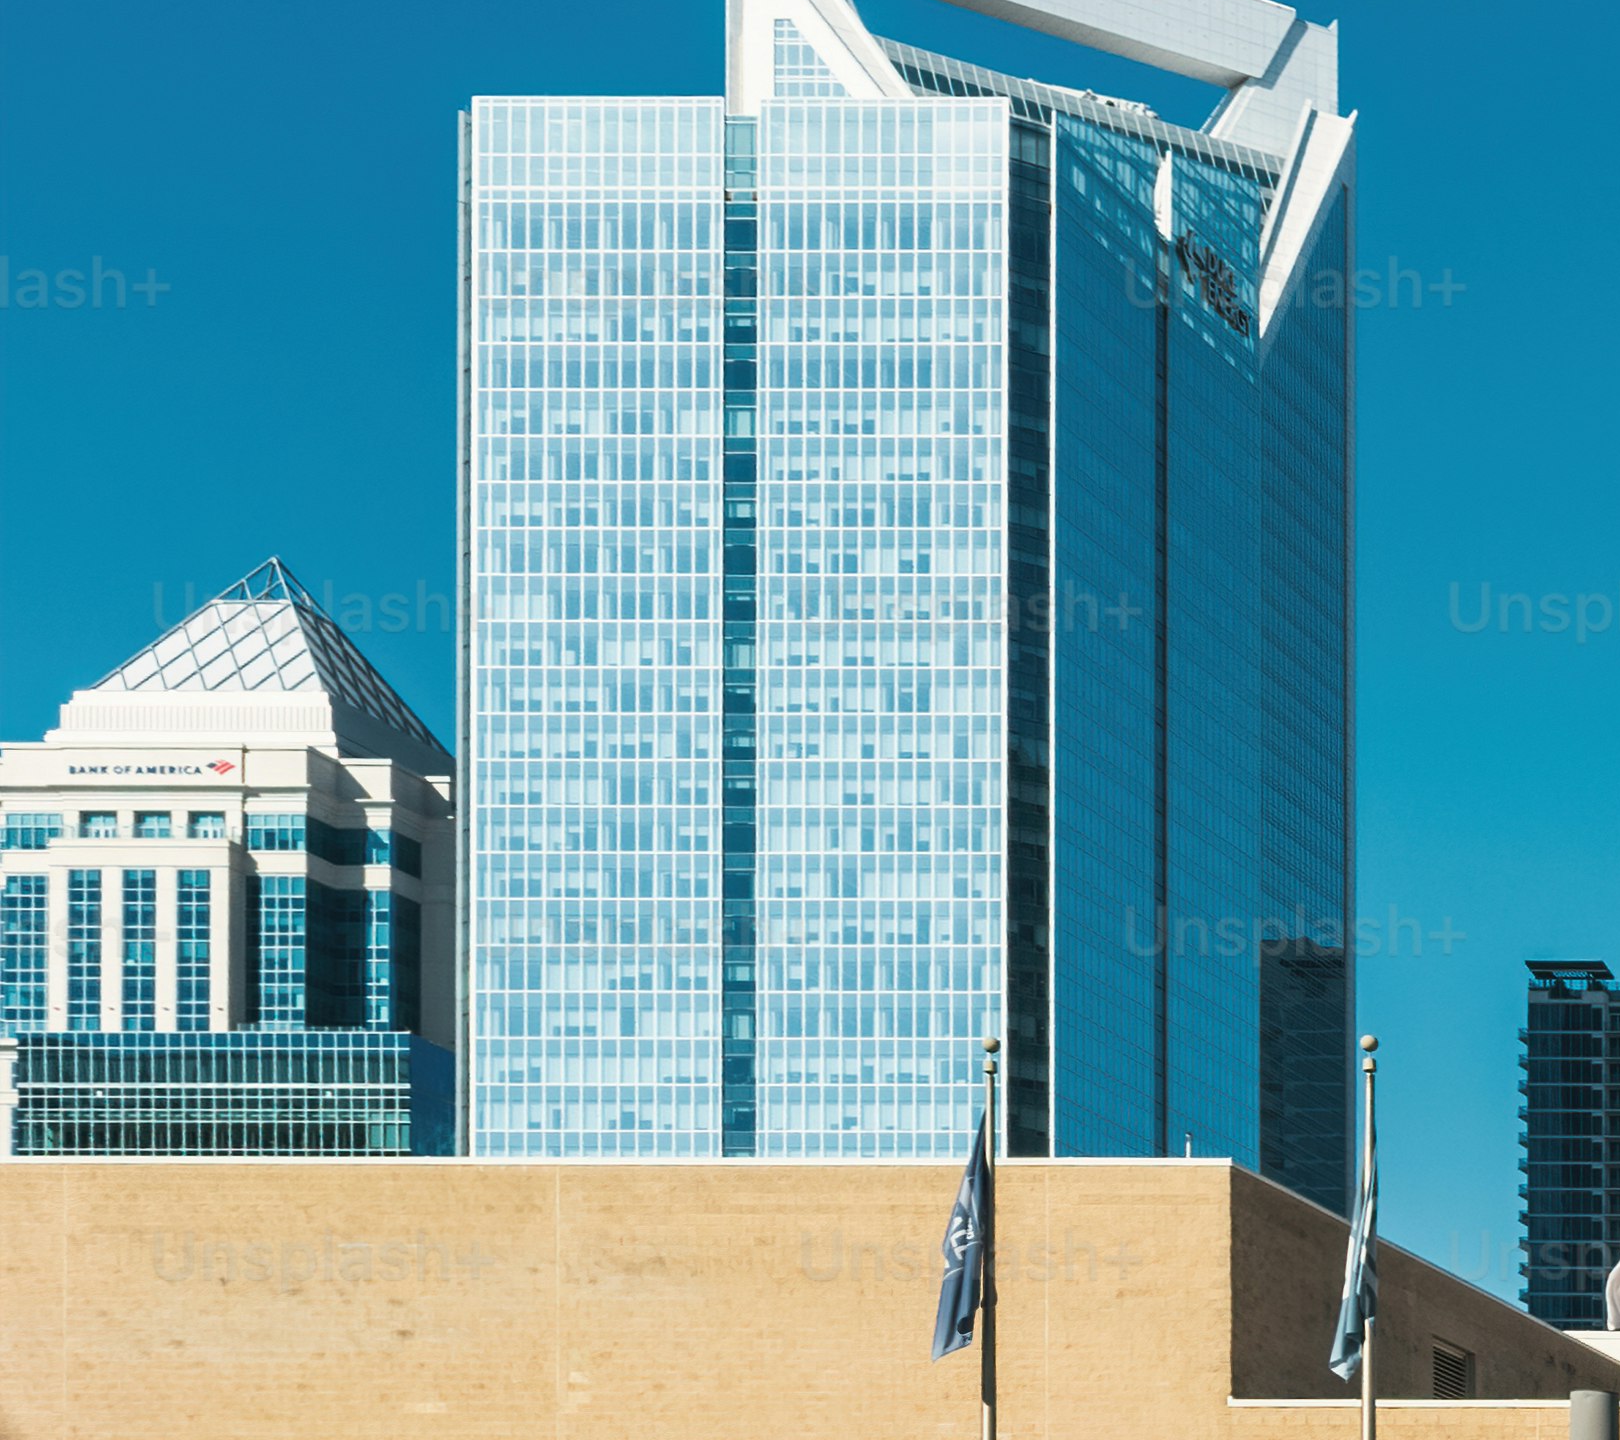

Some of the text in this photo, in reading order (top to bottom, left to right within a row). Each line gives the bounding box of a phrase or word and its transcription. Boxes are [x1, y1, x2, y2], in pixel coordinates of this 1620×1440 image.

[69, 765, 202, 775] BANK OF AMERICA
